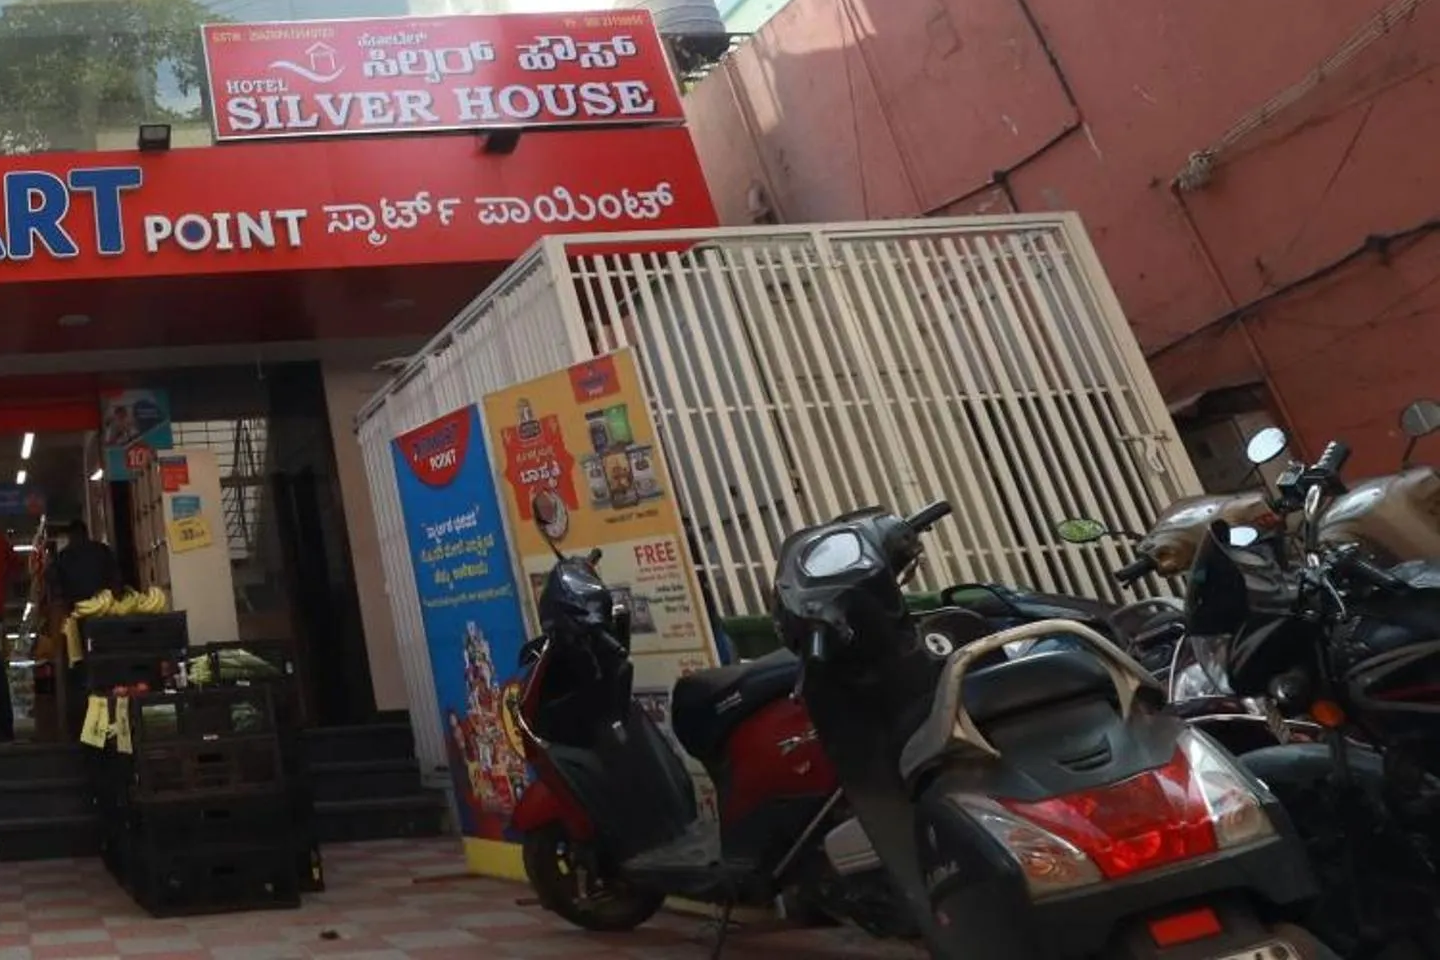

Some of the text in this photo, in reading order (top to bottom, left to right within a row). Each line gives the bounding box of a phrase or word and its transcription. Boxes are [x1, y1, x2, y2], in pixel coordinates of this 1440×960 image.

[226, 79, 289, 94] HOTEL
[227, 80, 655, 131] SILVER HOUSE
[143, 208, 308, 253] POINT
[634, 541, 676, 565] FREE
